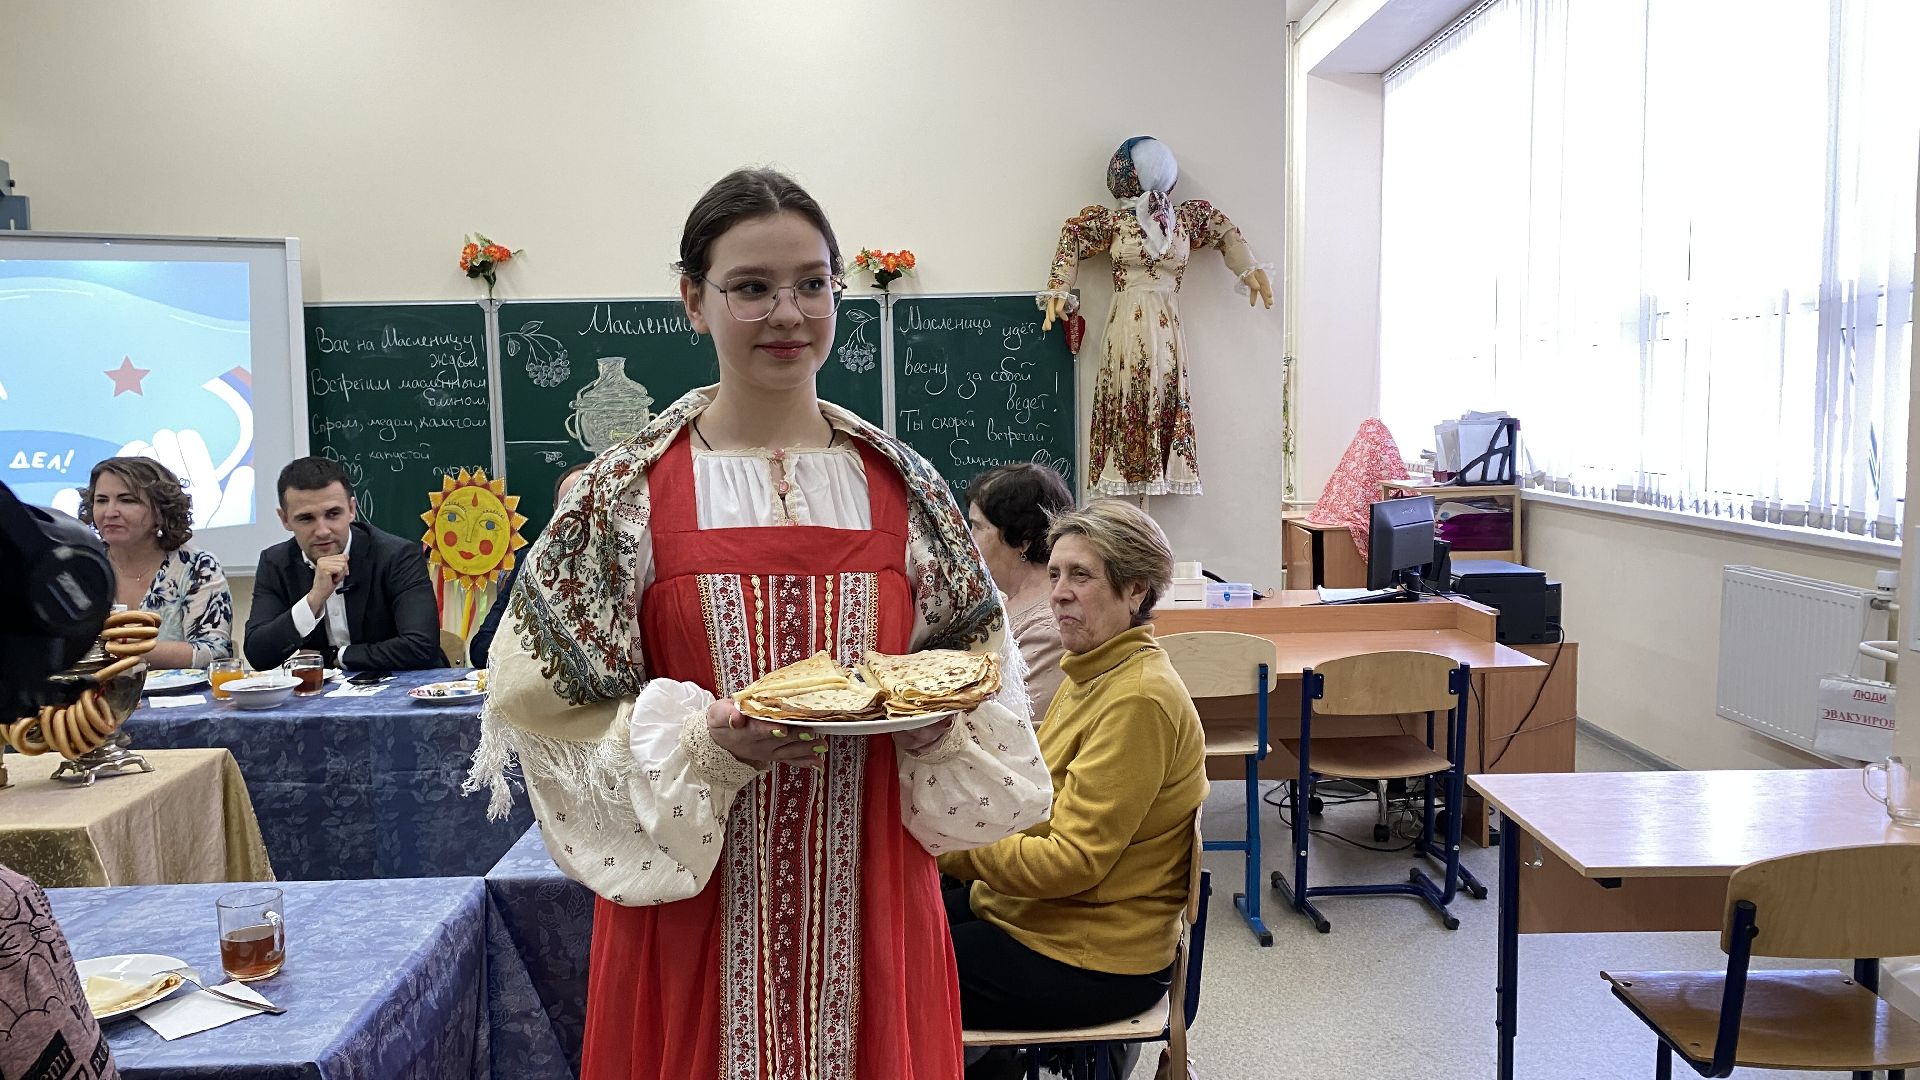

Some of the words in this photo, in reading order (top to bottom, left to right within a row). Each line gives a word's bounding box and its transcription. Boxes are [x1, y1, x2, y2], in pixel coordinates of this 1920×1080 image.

[577, 304, 701, 345] Маслениц
[895, 305, 992, 336] Масленица
[315, 326, 351, 353] Вас
[357, 339, 375, 351] на
[381, 327, 478, 367] Масленицу
[311, 368, 391, 402] Встретим
[904, 346, 948, 396] весну
[957, 371, 982, 400] за
[990, 356, 1036, 382] собой
[899, 409, 924, 433] Ты
[931, 410, 976, 438] скорей
[9, 448, 75, 475] ДЕЛ!
[321, 445, 347, 463] Да
[368, 442, 430, 473] капустой
[949, 438, 1021, 468] блинам
[1852, 689, 1887, 702] ЛЮДИ
[1823, 708, 1896, 729] ЭВАКУИРОВ
